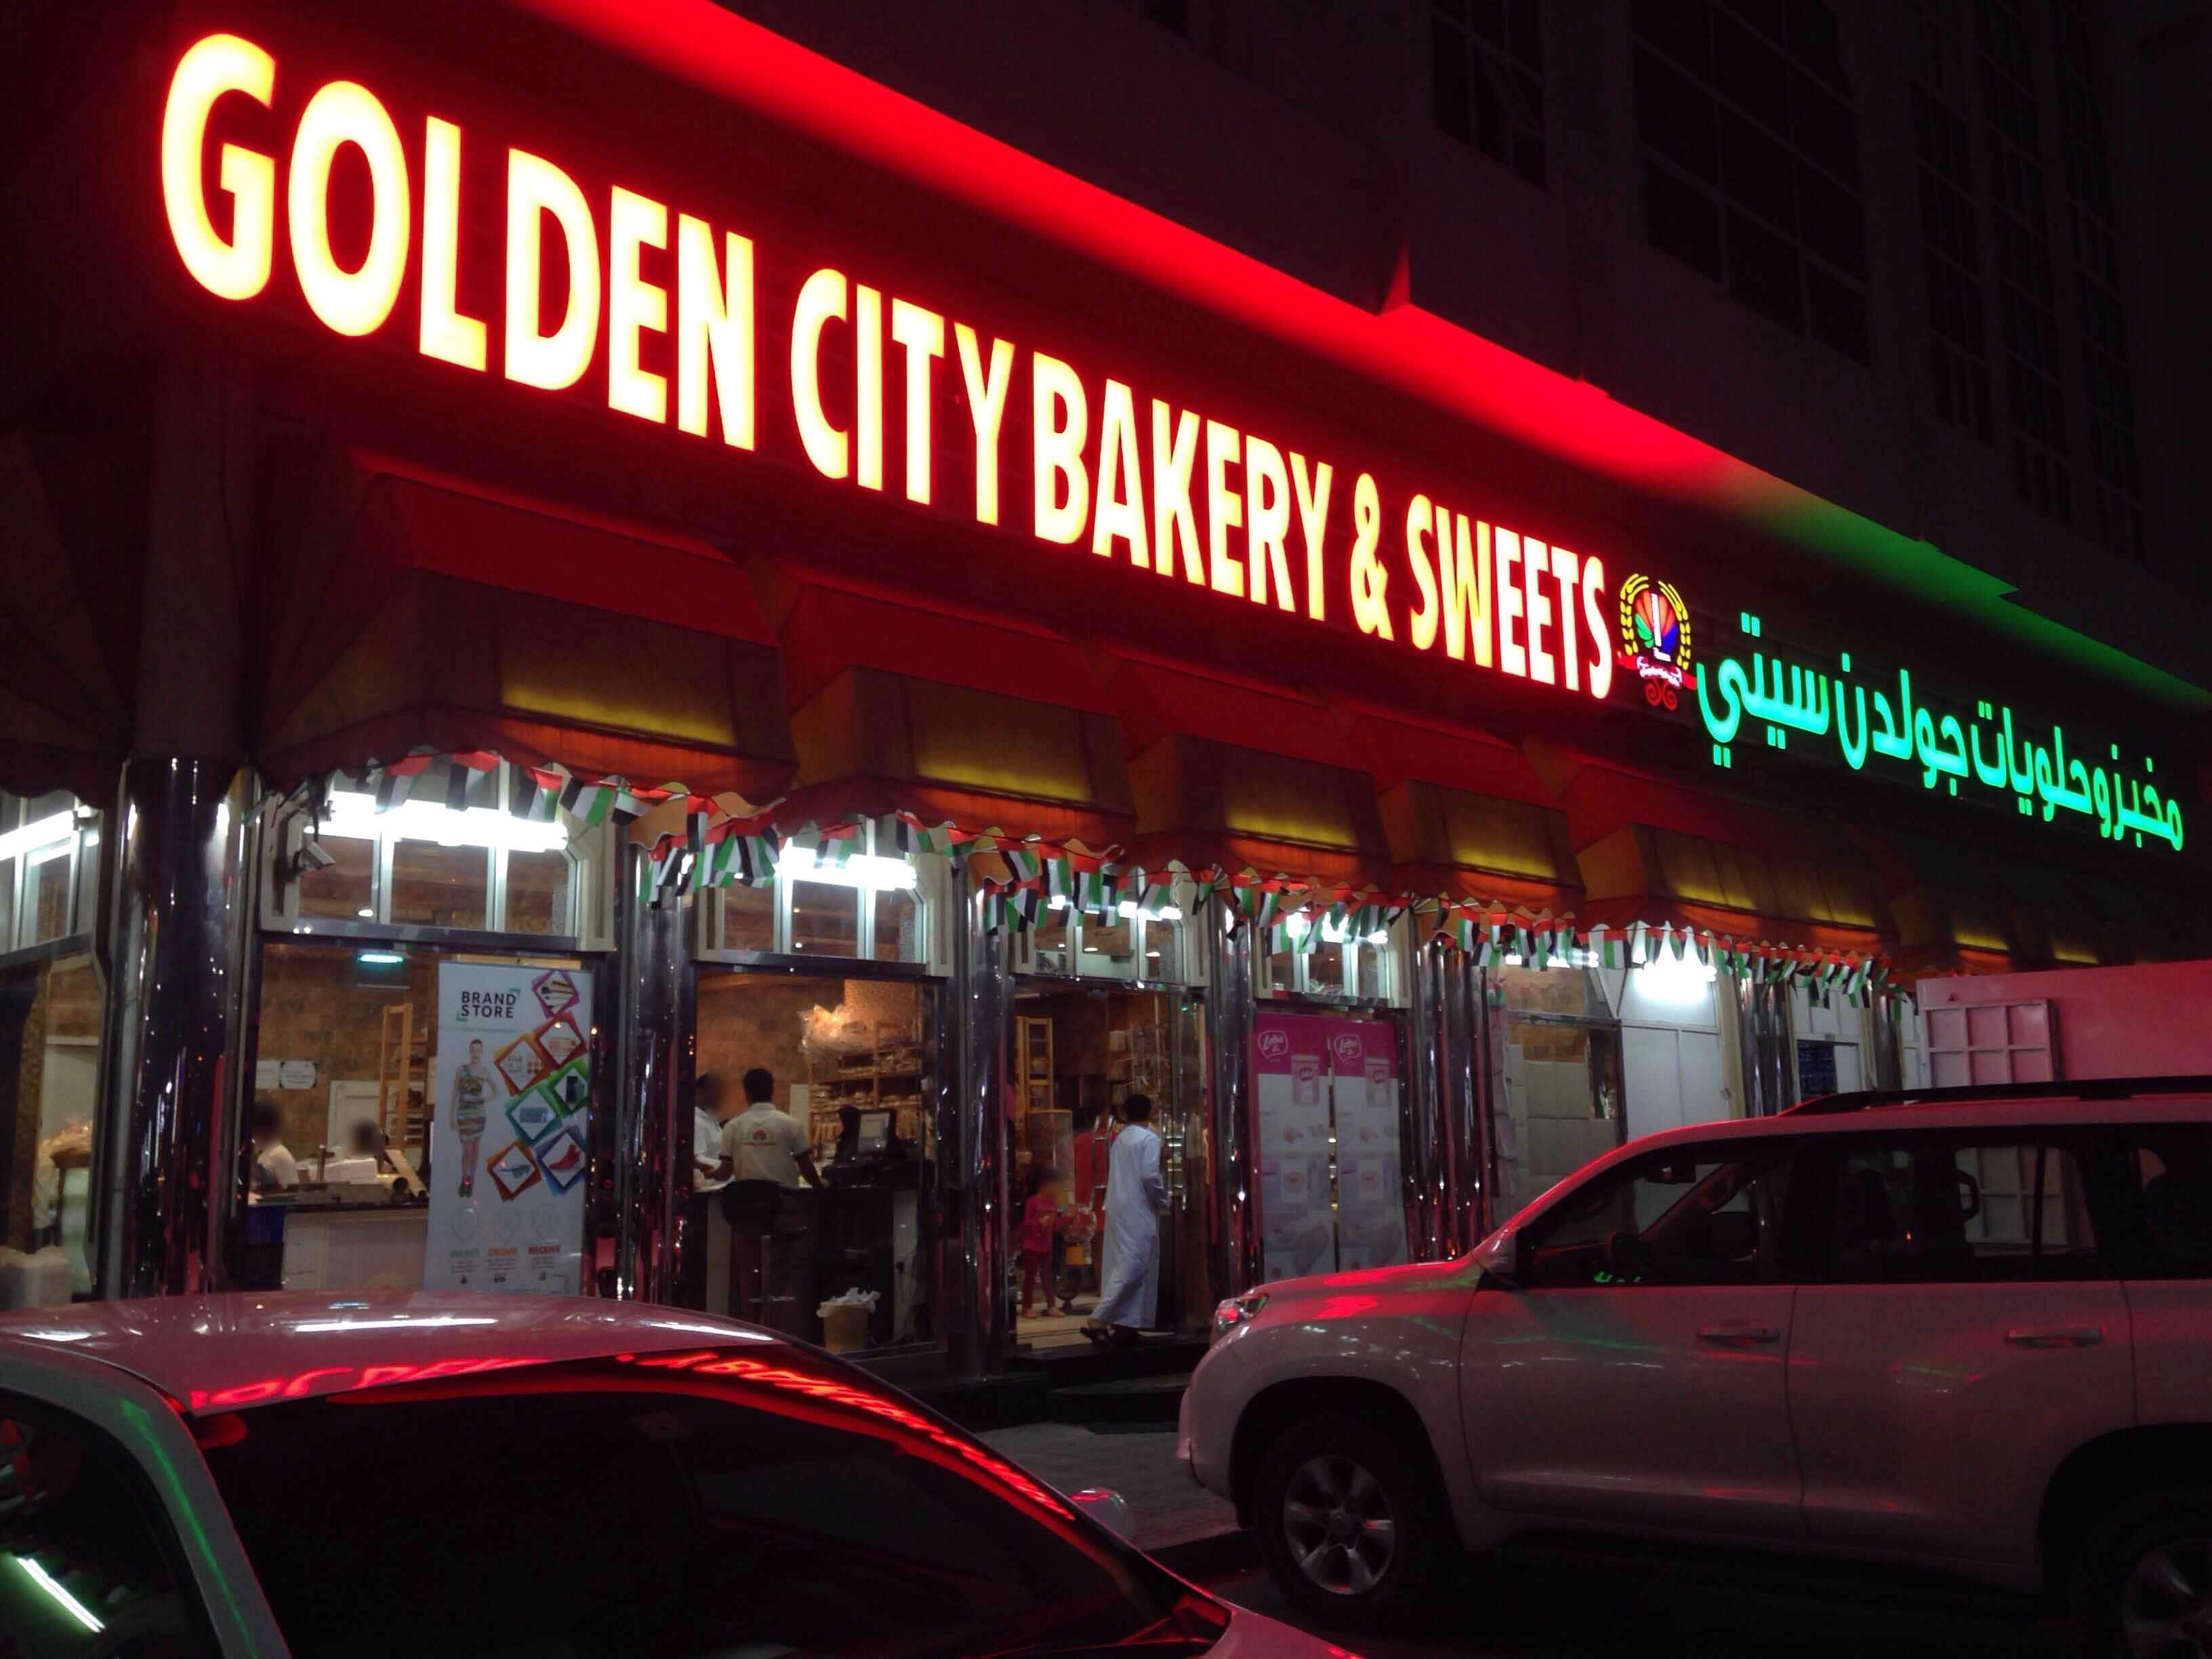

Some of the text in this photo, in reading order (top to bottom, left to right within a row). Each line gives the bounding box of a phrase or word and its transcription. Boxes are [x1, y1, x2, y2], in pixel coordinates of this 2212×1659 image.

[161, 33, 1613, 699] GOLDEN CITY BAKERY & SWEETS
[1695, 611, 1830, 769] سيتي
[1833, 652, 1969, 797] جولدن
[2111, 743, 2184, 852] مخبز
[461, 991, 516, 1006] BRAND
[461, 1004, 515, 1019] STORE
